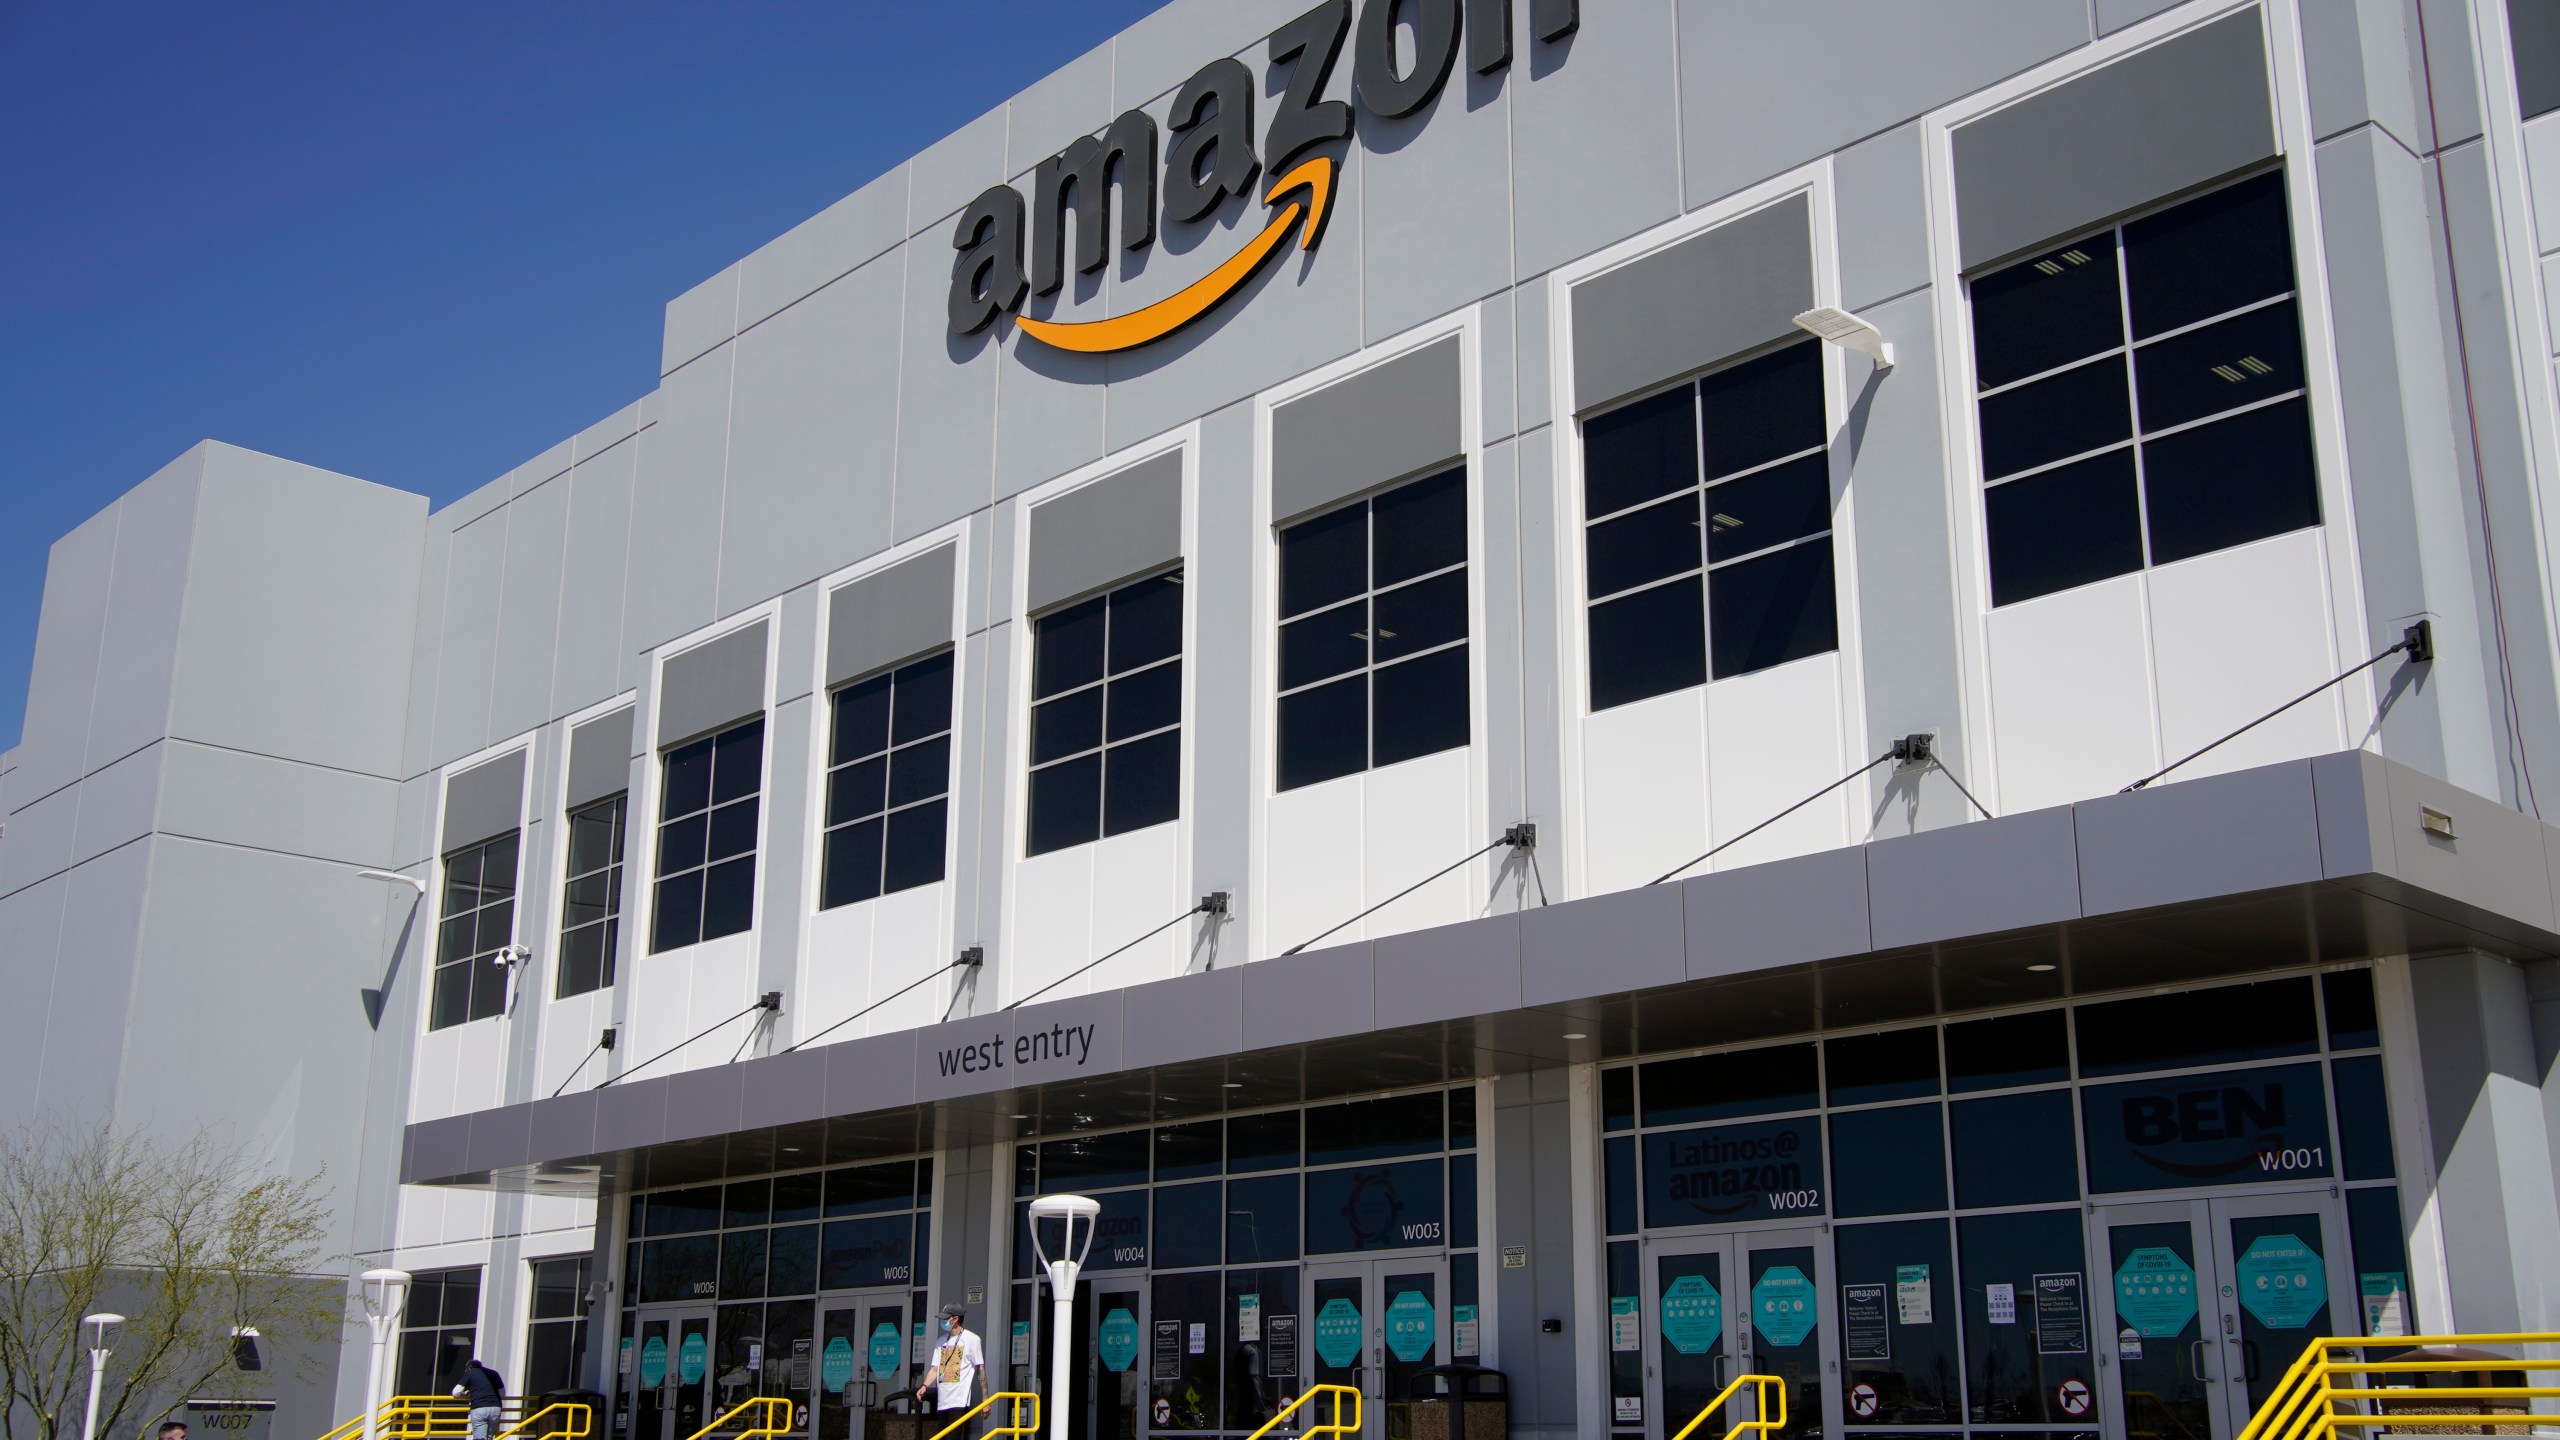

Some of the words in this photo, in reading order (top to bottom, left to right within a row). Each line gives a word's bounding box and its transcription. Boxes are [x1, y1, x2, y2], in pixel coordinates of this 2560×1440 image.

[938, 1033, 1004, 1077] west
[1014, 1023, 1095, 1065] entry
[2121, 1083, 2287, 1147] BEN
[1668, 1130, 1801, 1168] Latinos@
[2257, 1147, 2324, 1172] W001
[1669, 1162, 1801, 1201] amazon
[1768, 1189, 1819, 1210] W002
[1402, 1222, 1441, 1241] W003
[1114, 1246, 1145, 1263] W004
[1505, 1247, 1524, 1255] NOTICE
[2137, 1253, 2168, 1261] SYMPTOMS
[2262, 1250, 2275, 1258] NOT
[883, 1265, 909, 1280] W005
[693, 1281, 715, 1294] W006
[2040, 1278, 2076, 1288] amazon
[1849, 1288, 1881, 1298] amazon
[1271, 1319, 1294, 1327] amazon
[203, 1414, 253, 1430] W007
